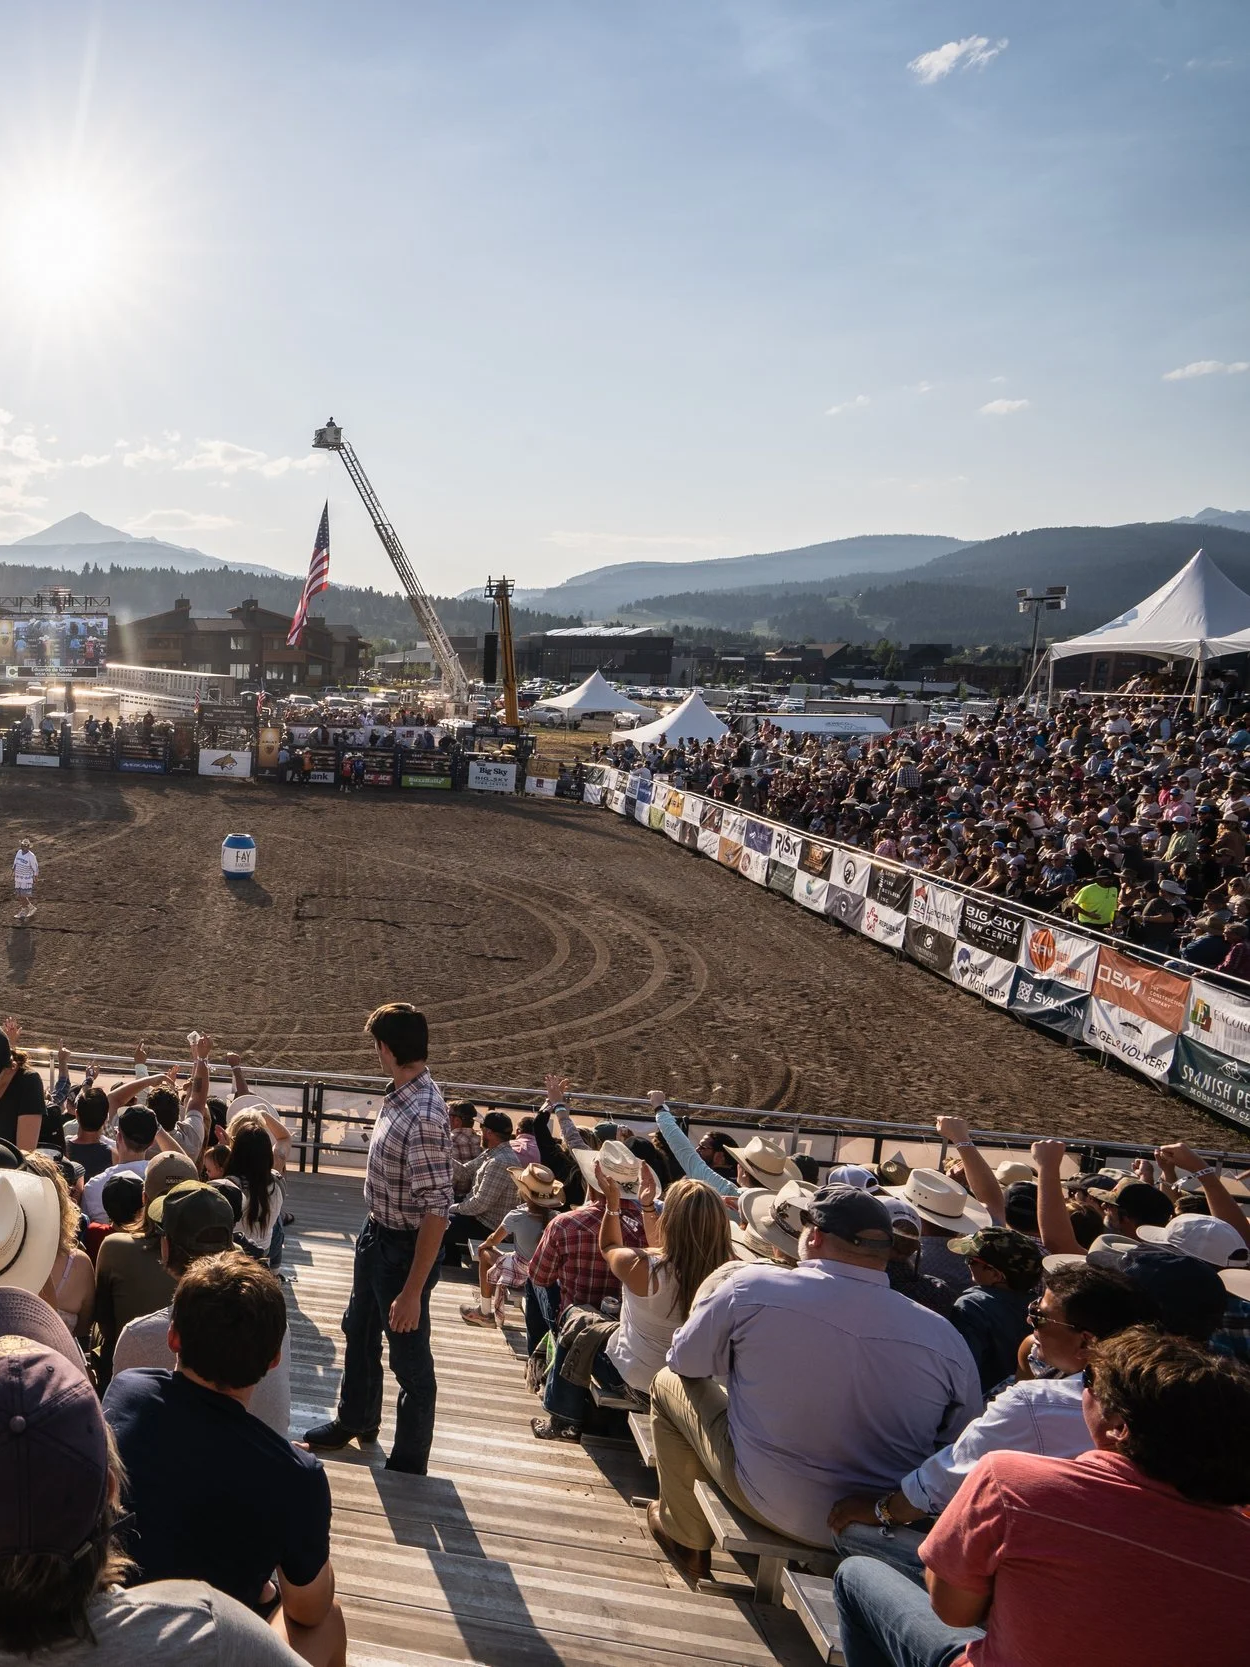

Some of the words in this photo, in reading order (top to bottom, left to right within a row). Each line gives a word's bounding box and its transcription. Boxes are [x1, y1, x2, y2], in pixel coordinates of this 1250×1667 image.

[479, 767, 492, 775] Big
[493, 768, 508, 776] Sky
[776, 833, 796, 857] RISK
[236, 851, 251, 863] FAY
[926, 906, 954, 923] Landmark
[966, 905, 988, 920] BIG
[992, 915, 1020, 933] SKY
[878, 919, 901, 934] REPUBLIC
[965, 920, 983, 933] TOWN
[985, 928, 1018, 945] CENTER
[970, 963, 988, 978] Stay
[968, 974, 1006, 999] Montana
[1150, 984, 1160, 992] THE
[1033, 992, 1084, 1020] SVALINN
[1147, 996, 1170, 1009] COMPANY
[1150, 991, 1185, 1008] CONSTRUCTION
[1182, 1064, 1232, 1100] SPANISH
[1190, 1087, 1237, 1114] MOUNTAIN
